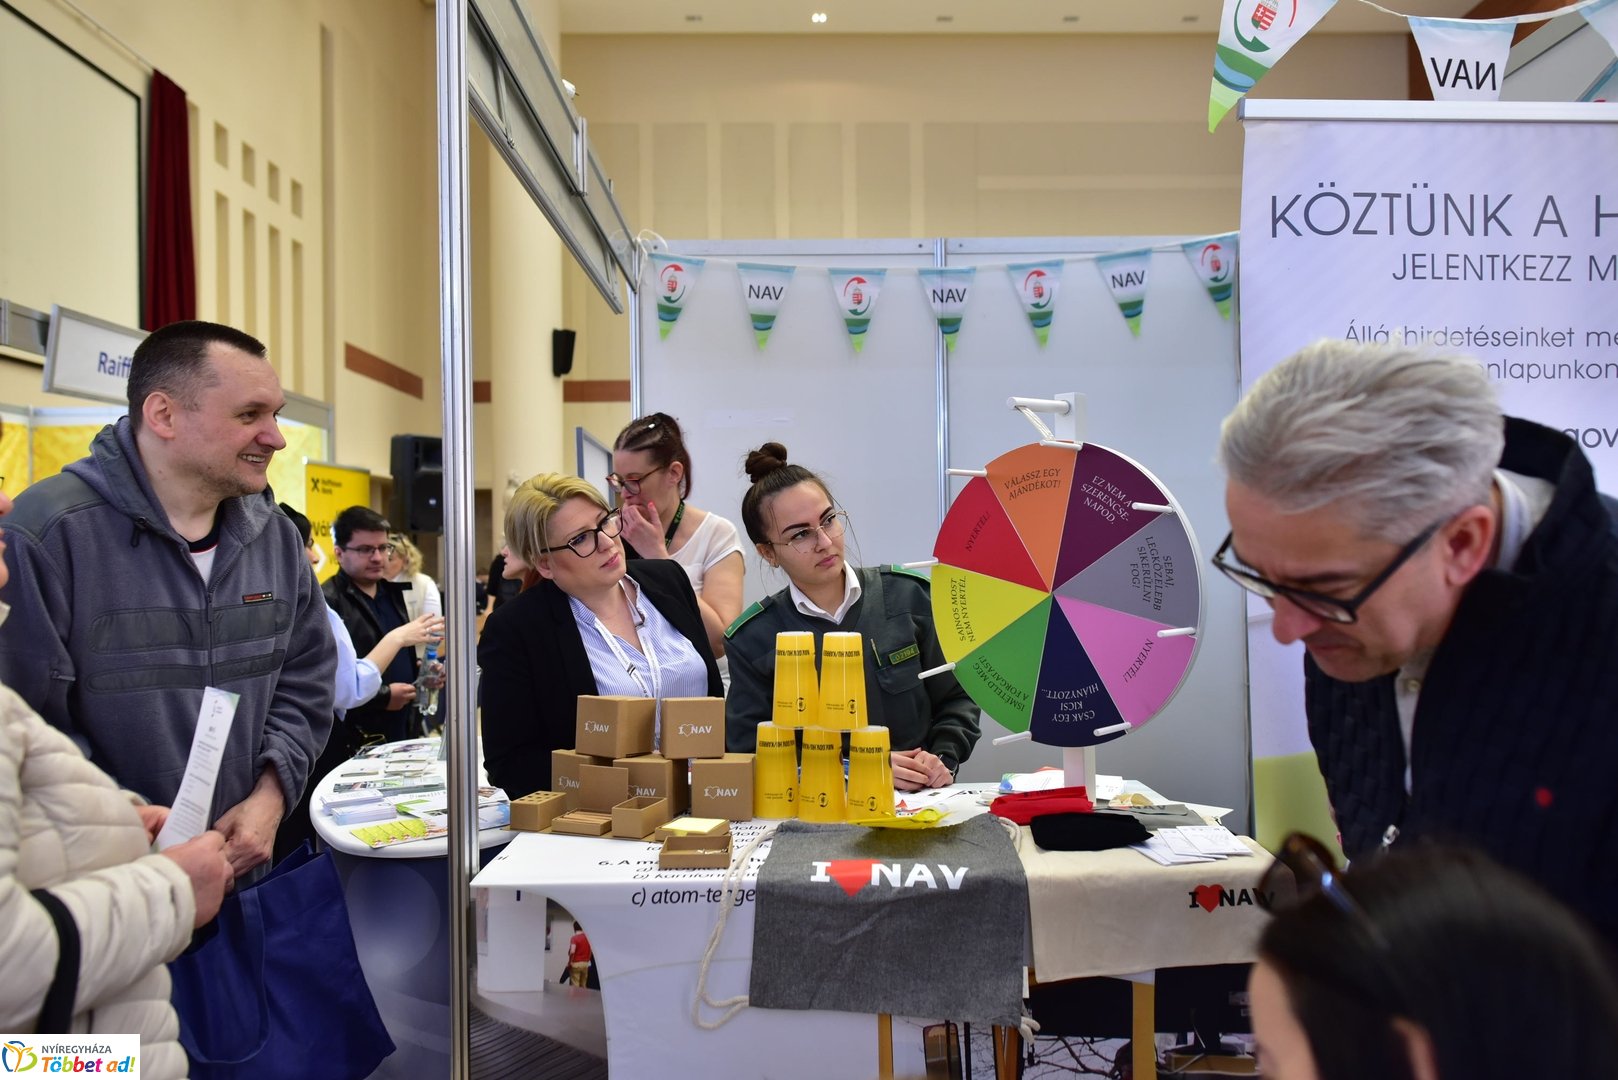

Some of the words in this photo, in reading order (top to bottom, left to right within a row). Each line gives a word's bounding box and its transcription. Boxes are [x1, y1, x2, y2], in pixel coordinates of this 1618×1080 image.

[1271, 182, 1513, 238] KÖZTÜNK
[1533, 195, 1569, 238] A
[1392, 253, 1572, 281] JELENTKEZZ
[1111, 270, 1145, 289] NAV
[749, 284, 784, 300] NAV
[932, 288, 967, 303] NAV
[1345, 319, 1575, 347] Álláhirdetéseinket
[1477, 359, 1618, 383] nlapunkon
[1004, 469, 1041, 490] VÁLASSZ
[1043, 468, 1061, 478] EGY
[1009, 479, 1061, 500] AJÁNDÉKOT!
[1080, 483, 1130, 522] SZERENCSE-
[1092, 475, 1106, 488] EZ
[1104, 482, 1126, 501] NEM
[1123, 499, 1132, 508] A
[1083, 496, 1116, 525] NAPOD.
[1130, 563, 1141, 589] FOG!
[1137, 546, 1153, 603] SIKERÜLNI
[1145, 536, 1163, 612] LEGKÖZELEBB
[1162, 555, 1175, 588] SEBAJ,
[950, 577, 958, 605] MOST
[952, 608, 966, 642] SAJNOS
[964, 621, 976, 642] NEM
[972, 662, 990, 682] MEG
[1122, 638, 1154, 683] NYERTÉL!
[986, 680, 1025, 712] ISMÉTELD
[1060, 701, 1083, 711] KICSI
[1052, 713, 1070, 722] EGY
[1072, 709, 1095, 722] CSAK
[593, 723, 610, 733] NAV
[690, 725, 712, 734] NAV
[567, 779, 580, 789] NAV
[636, 788, 656, 796] NAV
[716, 788, 738, 797] NAV
[810, 861, 832, 882] I
[871, 863, 969, 890] NAV
[631, 887, 647, 907] c)
